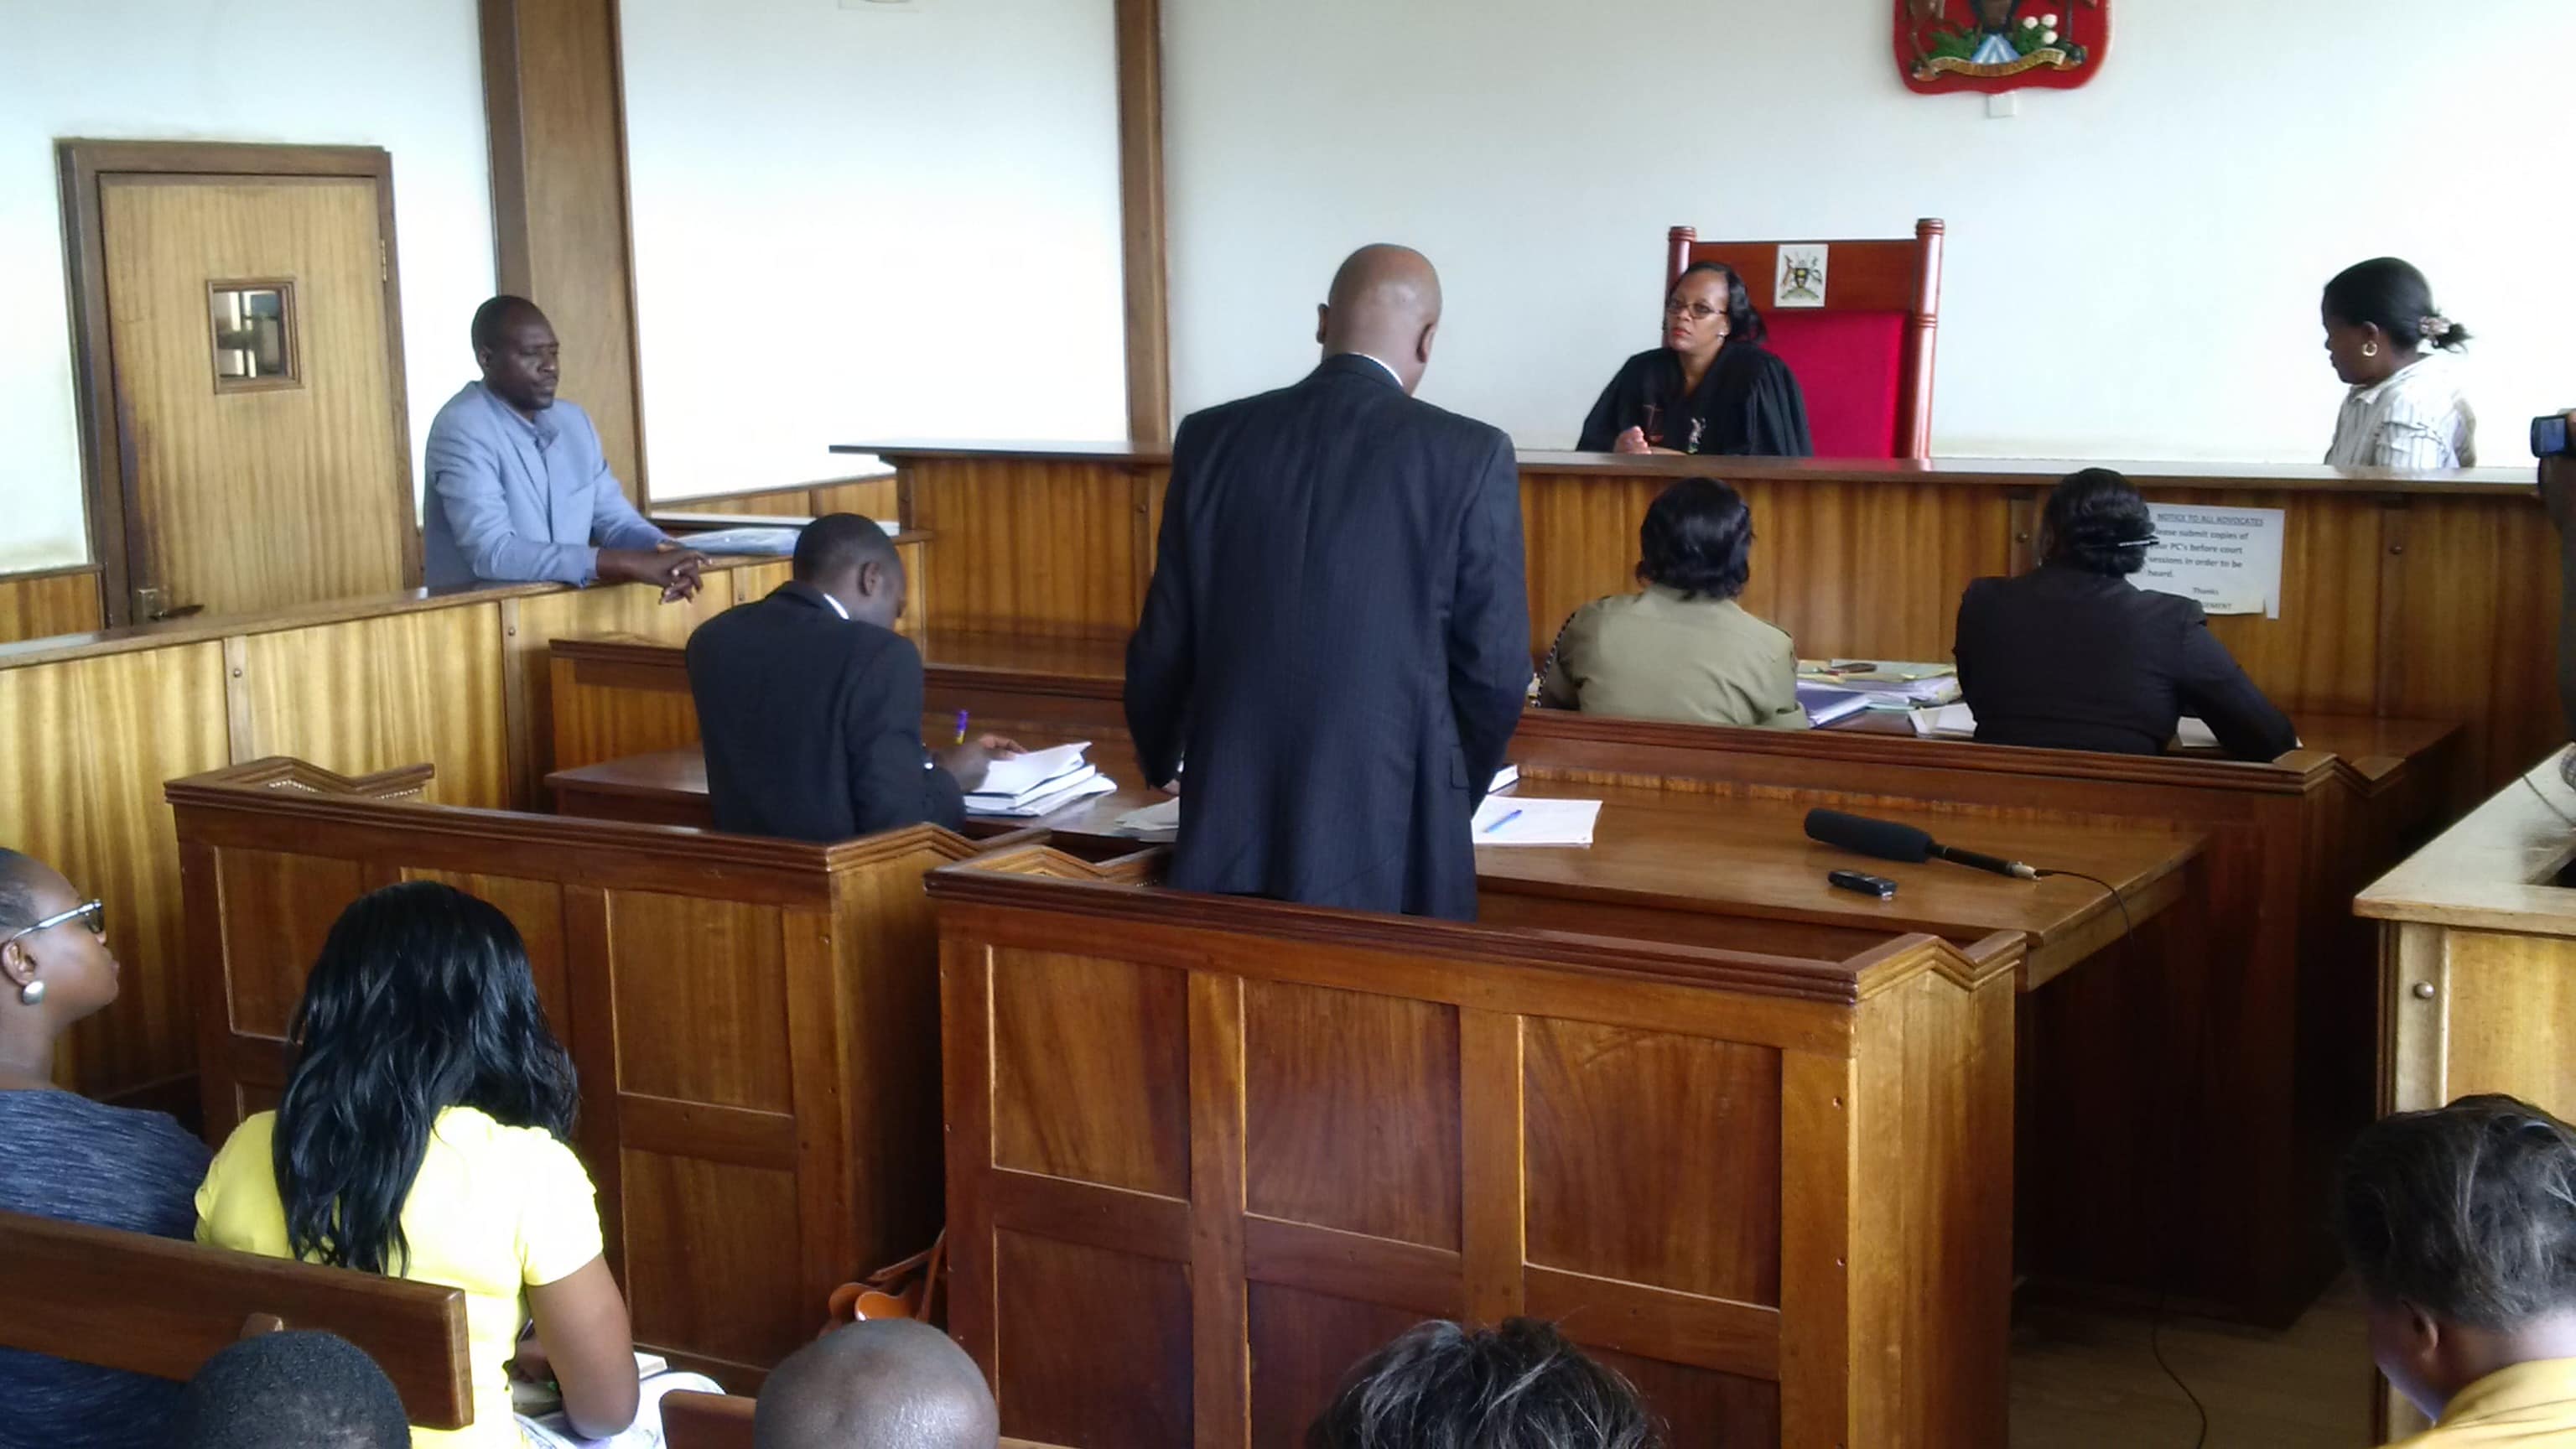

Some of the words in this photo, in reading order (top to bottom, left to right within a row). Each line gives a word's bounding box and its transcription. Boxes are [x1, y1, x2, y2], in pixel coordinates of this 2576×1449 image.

[2158, 513, 2186, 522] NOTICE
[2189, 515, 2199, 523] TO
[2201, 516, 2213, 524] ALL
[2216, 517, 2263, 526] ADVOCATES
[2202, 602, 2231, 610] GEMENT
